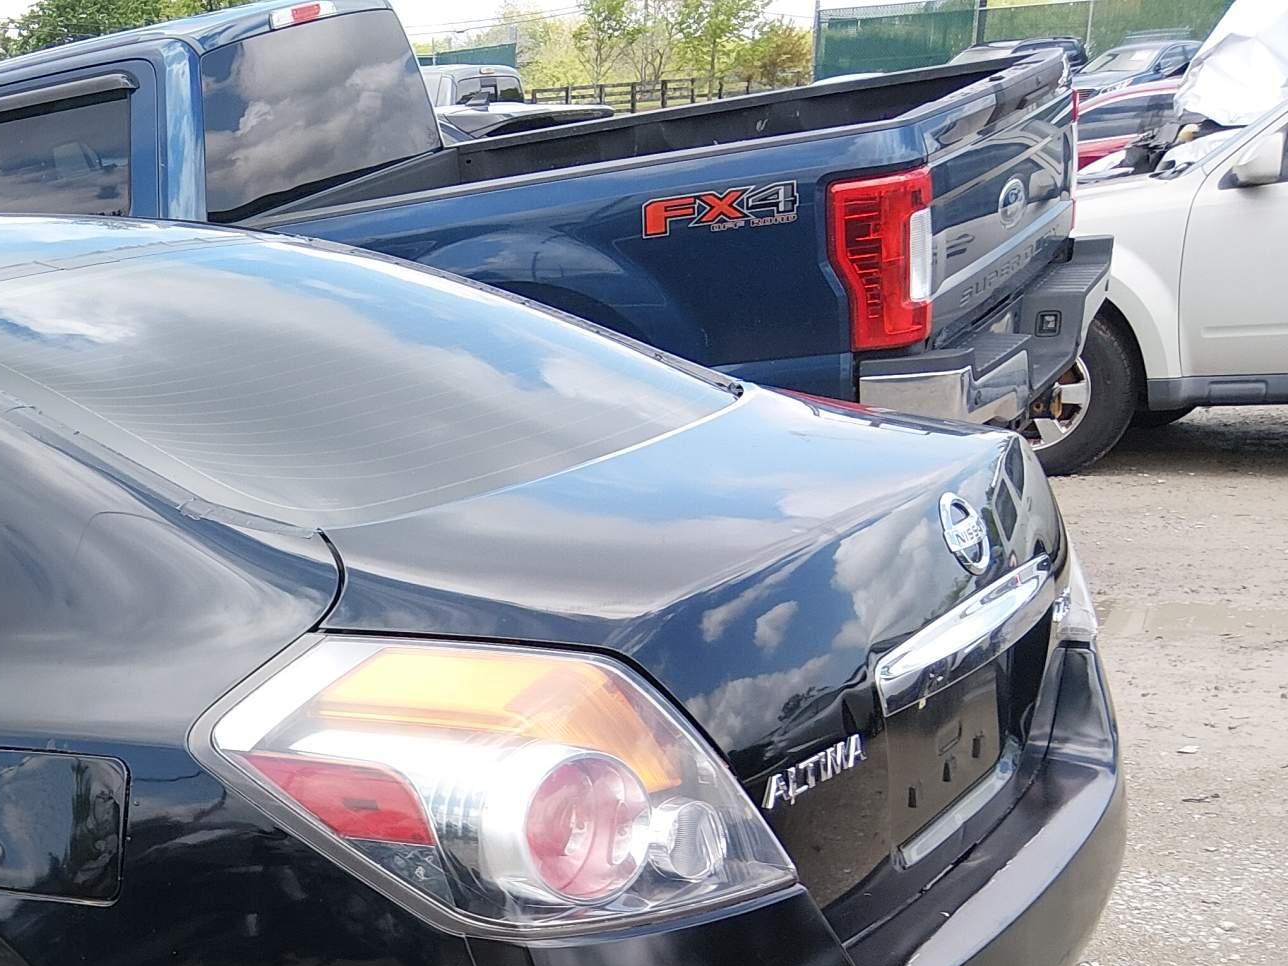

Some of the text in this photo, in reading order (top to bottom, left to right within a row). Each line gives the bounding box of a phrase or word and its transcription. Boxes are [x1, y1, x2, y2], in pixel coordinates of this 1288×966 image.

[642, 180, 799, 238] FX4
[710, 214, 798, 232] OFF ROAD
[959, 253, 1023, 308] SUPER
[761, 733, 867, 810] ALTIMA
